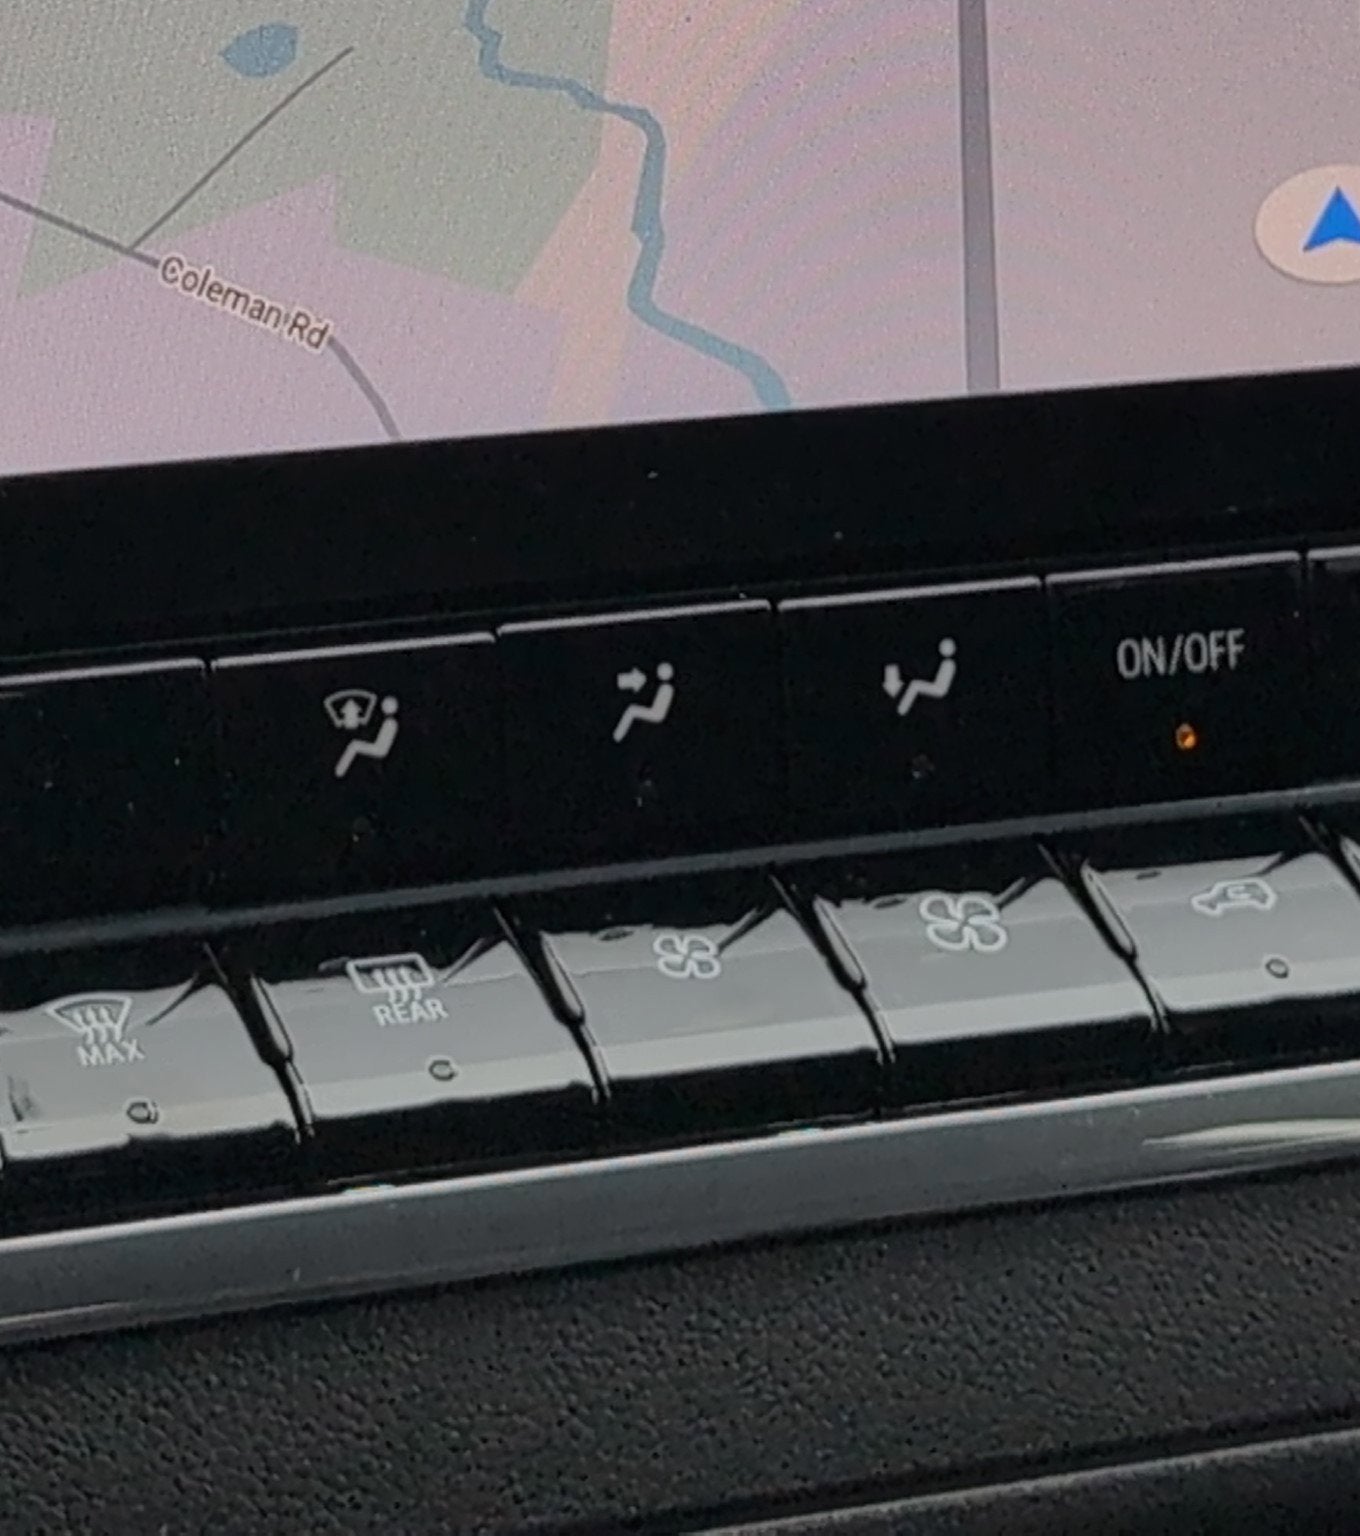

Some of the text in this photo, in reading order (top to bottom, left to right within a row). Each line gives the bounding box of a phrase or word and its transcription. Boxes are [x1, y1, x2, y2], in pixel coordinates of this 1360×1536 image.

[159, 255, 333, 351] Coleman Rd
[1115, 628, 1245, 681] ON/OFF
[371, 996, 451, 1029] REAR
[76, 1039, 146, 1068] MAX
